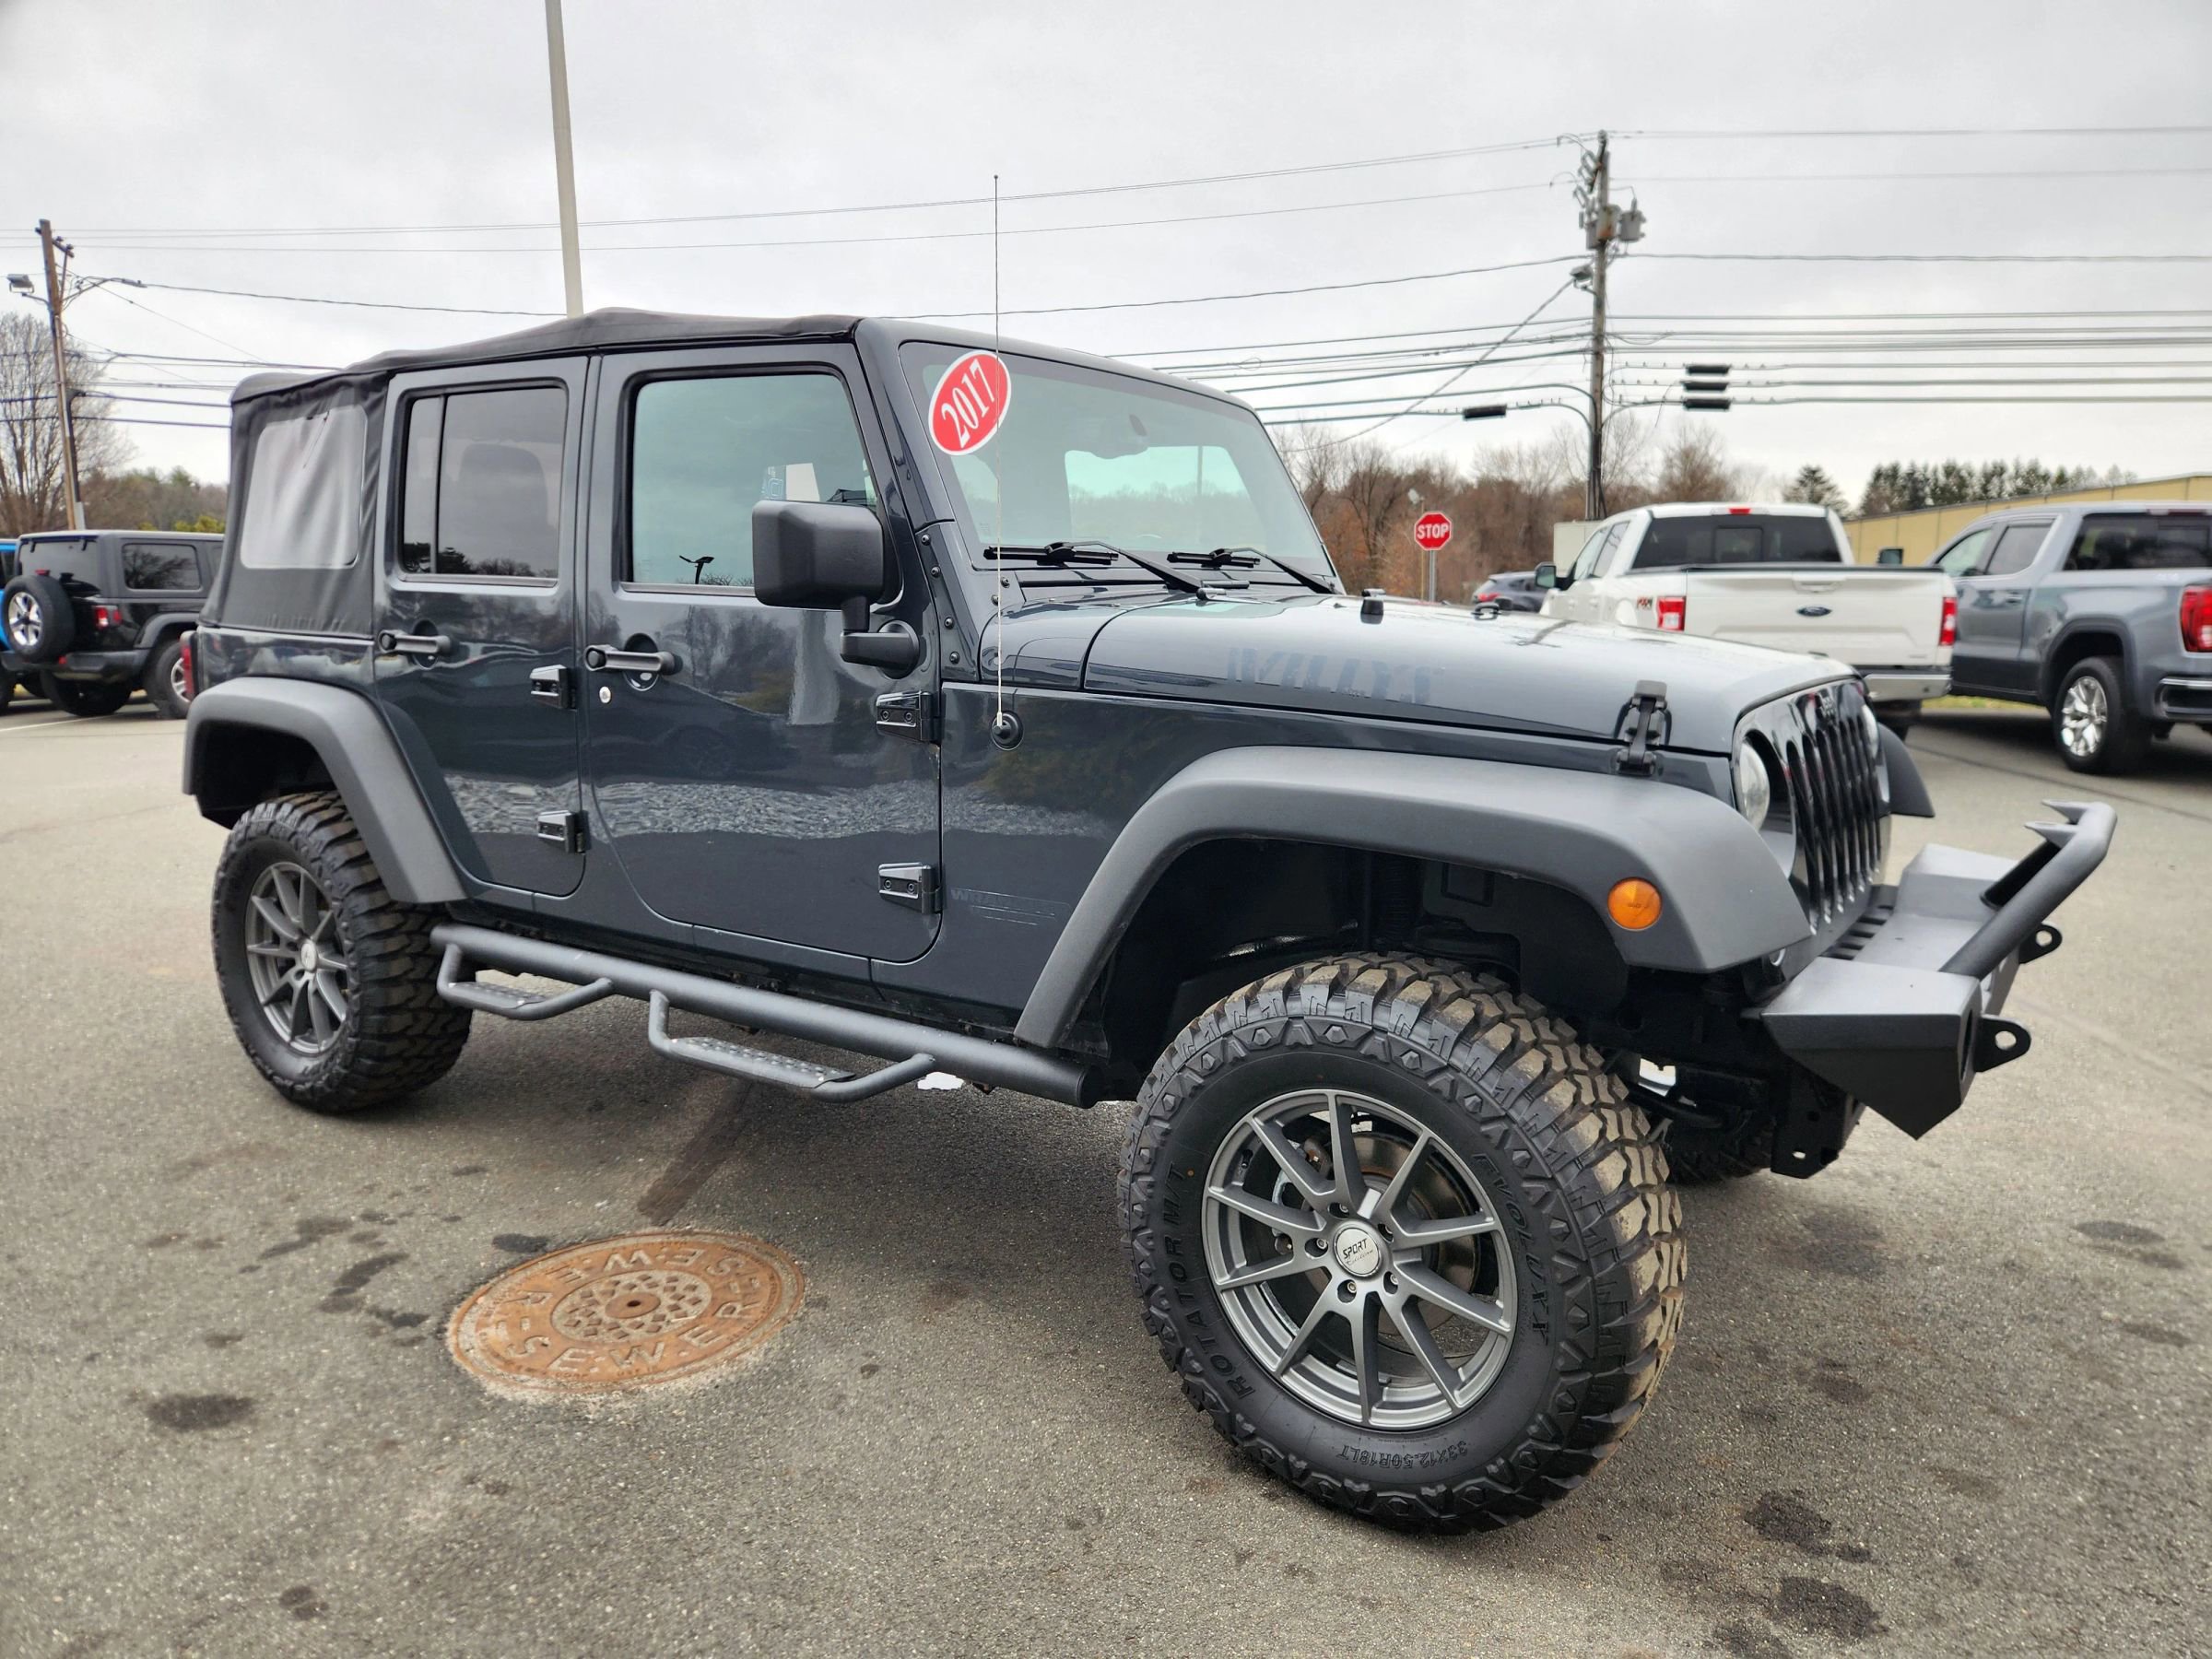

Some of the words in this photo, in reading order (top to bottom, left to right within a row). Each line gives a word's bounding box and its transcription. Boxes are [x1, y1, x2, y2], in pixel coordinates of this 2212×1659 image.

[941, 358, 995, 449] 2017
[1417, 523, 1449, 539] STOP
[1162, 1161, 1186, 1226] M/T
[1343, 1238, 1367, 1259] SPORT
[1164, 1236, 1254, 1399] ROTATOR
